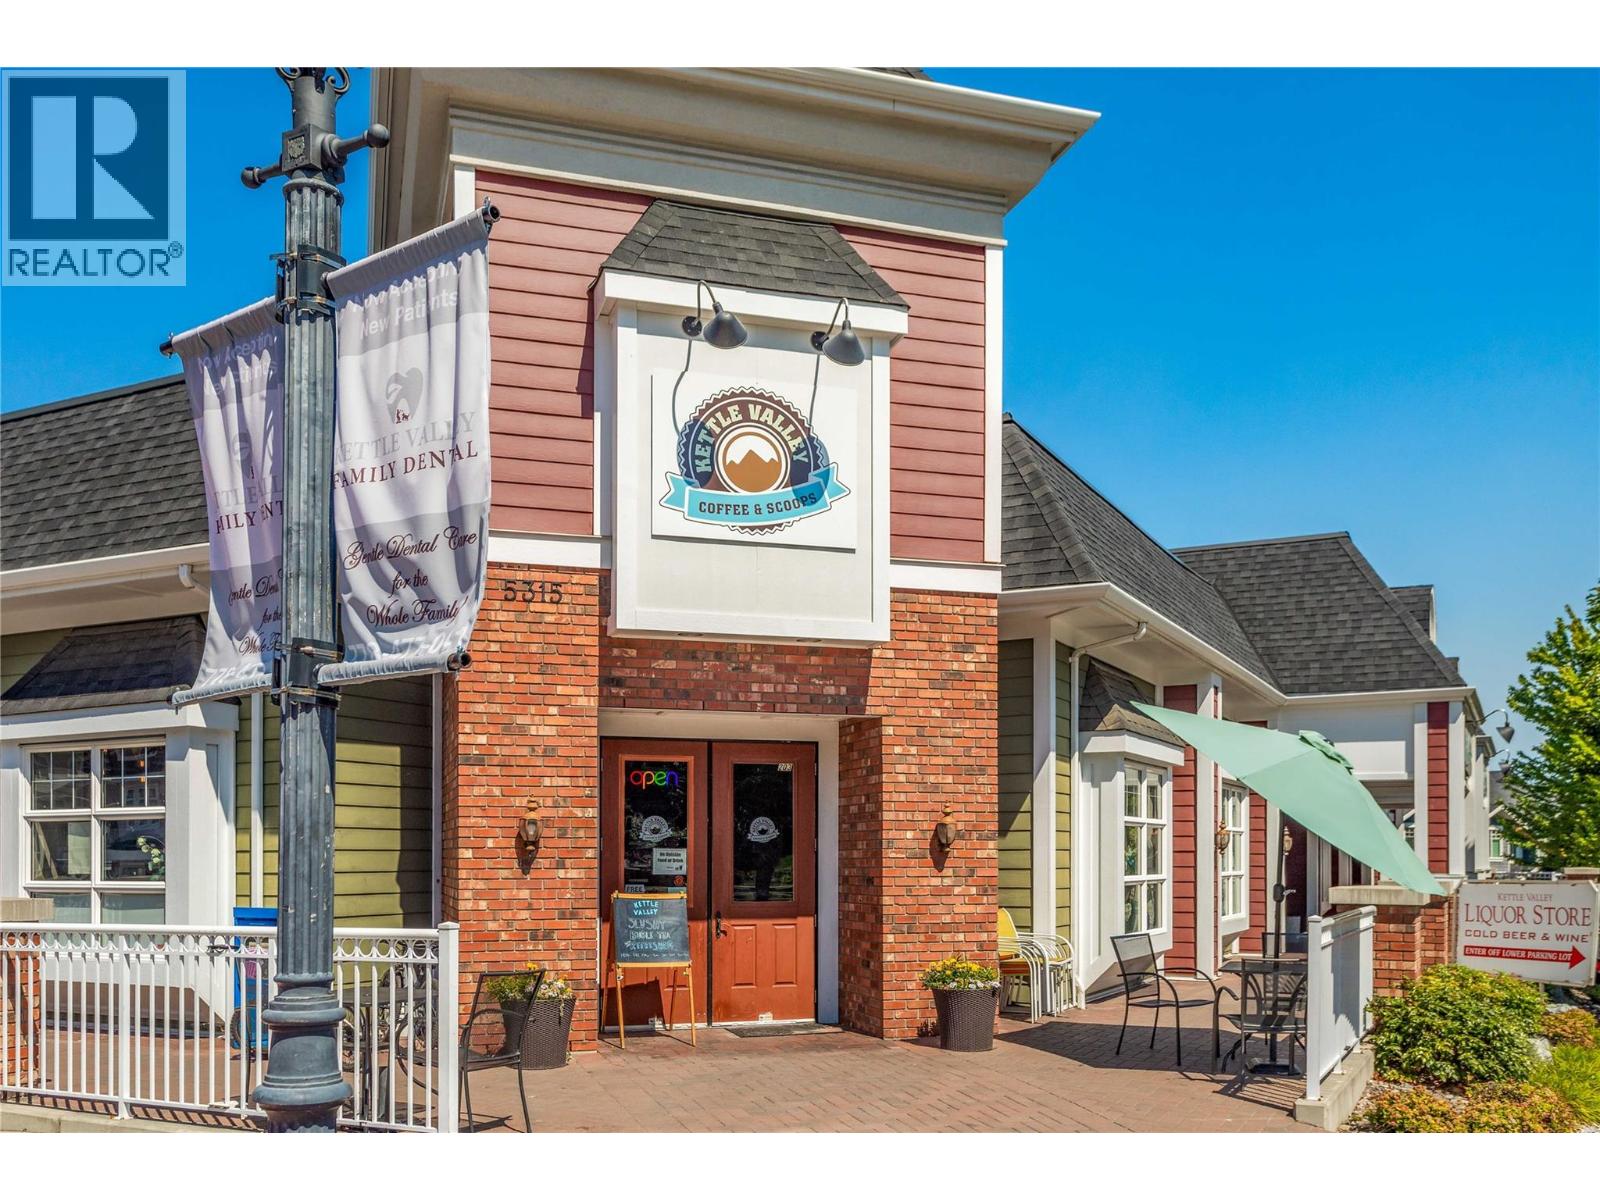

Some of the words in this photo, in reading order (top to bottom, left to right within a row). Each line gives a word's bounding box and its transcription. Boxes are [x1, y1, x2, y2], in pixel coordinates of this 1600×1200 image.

[394, 287, 457, 326] Patints
[406, 411, 477, 447] VALLY
[694, 404, 743, 473] KETTLE
[747, 403, 809, 463] VALLEY
[403, 440, 479, 475] DENTAL
[699, 500, 750, 516] COFFEE
[754, 502, 763, 515] &
[767, 492, 818, 515] SCOOPS
[343, 540, 384, 570] Gentle
[386, 533, 440, 559] Dental
[388, 571, 411, 598] for
[413, 569, 428, 587] the
[504, 580, 563, 604] 5315
[366, 600, 409, 626] Whole
[411, 596, 468, 626] Family
[629, 770, 679, 790] open
[1464, 903, 1528, 926] LIQUOR
[1533, 904, 1592, 927] STORE
[1465, 929, 1498, 938] COLD
[1503, 931, 1536, 940] BEER
[1541, 933, 1549, 941] &
[1555, 933, 1589, 943] WINE
[1465, 946, 1487, 955] ENTER
[1487, 948, 1500, 956] OFF
[1502, 949, 1526, 958] LOWER
[1527, 951, 1558, 960] PARKING
[1559, 953, 1573, 961] LOT
